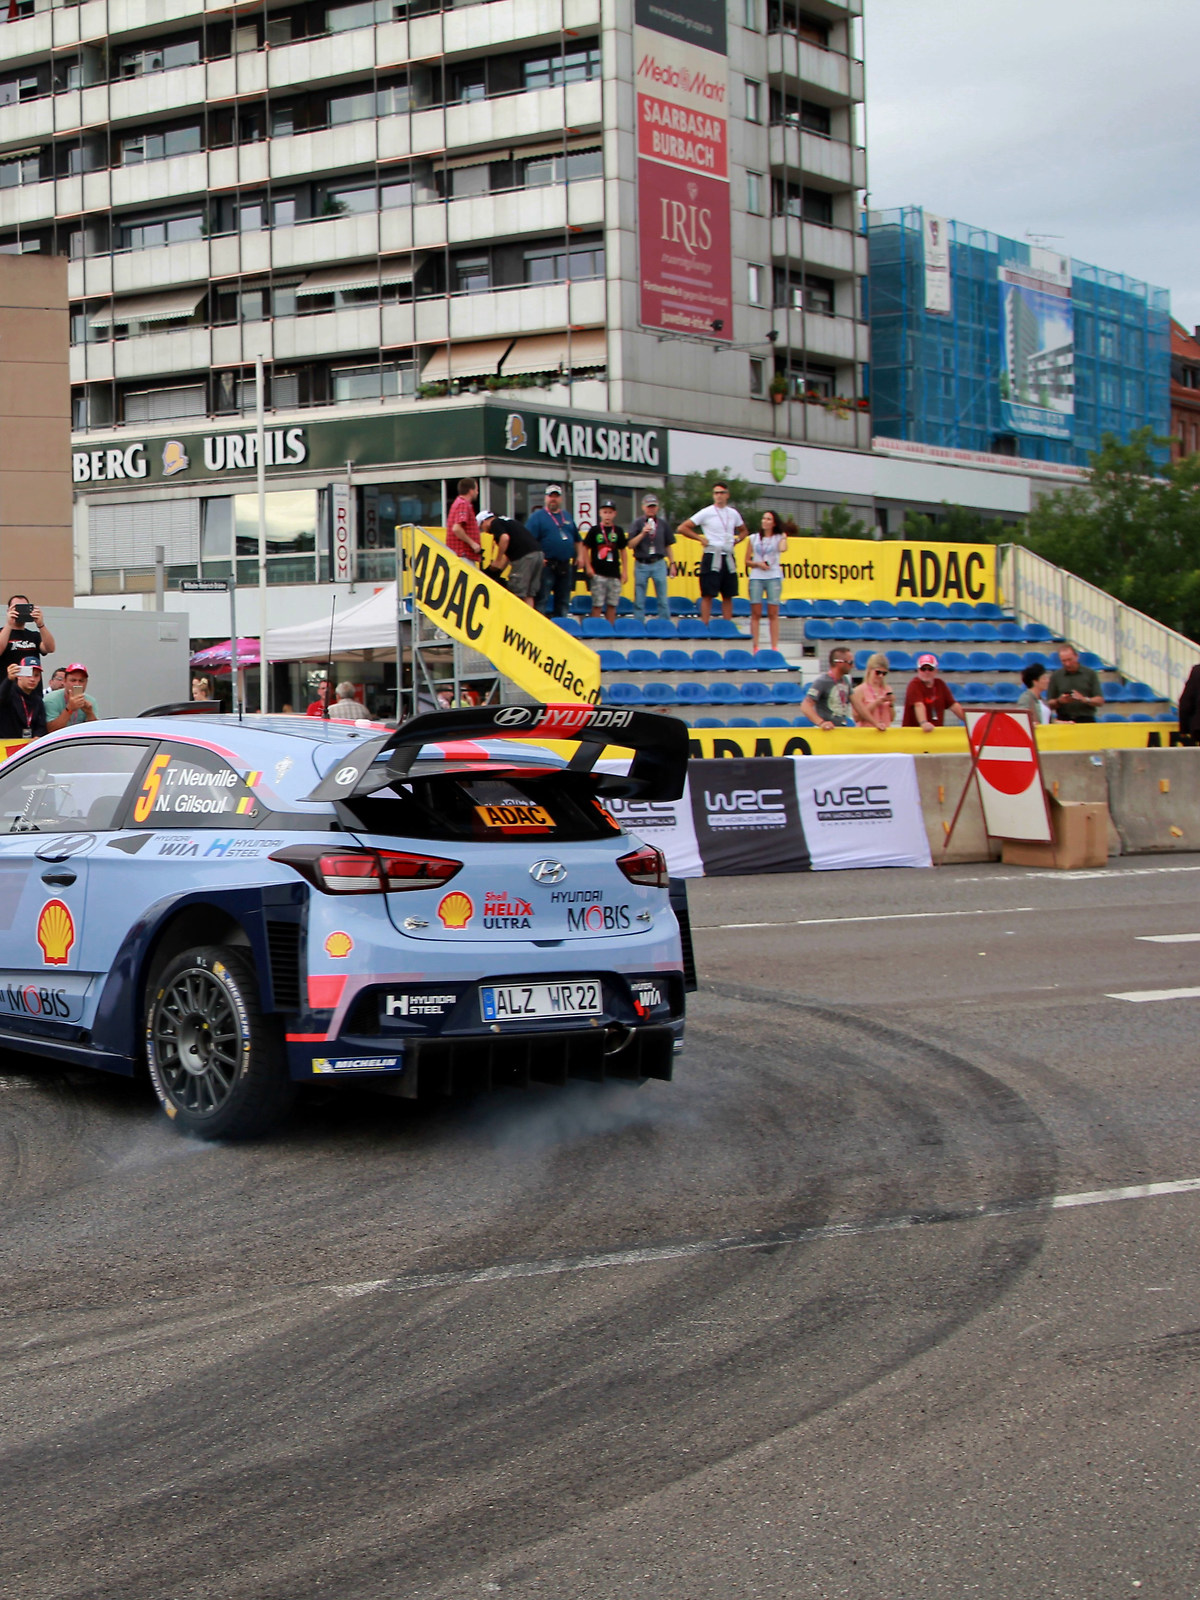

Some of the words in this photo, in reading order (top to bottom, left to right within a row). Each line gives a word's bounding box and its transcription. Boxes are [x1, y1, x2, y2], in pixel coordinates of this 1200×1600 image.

[637, 54, 680, 88] Media
[643, 99, 722, 143] SAARBASAR
[652, 130, 715, 168] BURBACH
[660, 198, 712, 255] IRIS
[538, 417, 660, 467] KARLSBERG
[337, 508, 348, 578] ROOM
[896, 550, 986, 600] ADAC
[414, 543, 490, 641] ADAC
[503, 625, 600, 704] www.adac.d
[532, 710, 634, 728] HYUNDAI
[165, 769, 176, 786] T.
[178, 769, 238, 787] Neuville
[133, 754, 171, 823] 5
[813, 785, 890, 807] WRC
[155, 795, 171, 813] N.
[174, 795, 228, 814] Gilsoul
[704, 789, 785, 811] WRC
[485, 807, 546, 825] ADAC
[158, 841, 201, 857] WIA
[225, 849, 261, 857] STEEL
[234, 839, 285, 848] HYUNDAI
[485, 891, 508, 901] Shell
[551, 890, 603, 903] HYUNDAI
[484, 902, 535, 916] HELIX
[567, 905, 630, 932] MOBIS
[484, 917, 532, 929] ULTRA
[6, 983, 70, 1018] MOBIS
[409, 995, 456, 1005] HYUNDAI
[497, 987, 536, 1015] ALZ
[639, 988, 661, 1007] WIA
[409, 1005, 445, 1015] STEEL
[334, 1058, 398, 1069] MICHELIN
